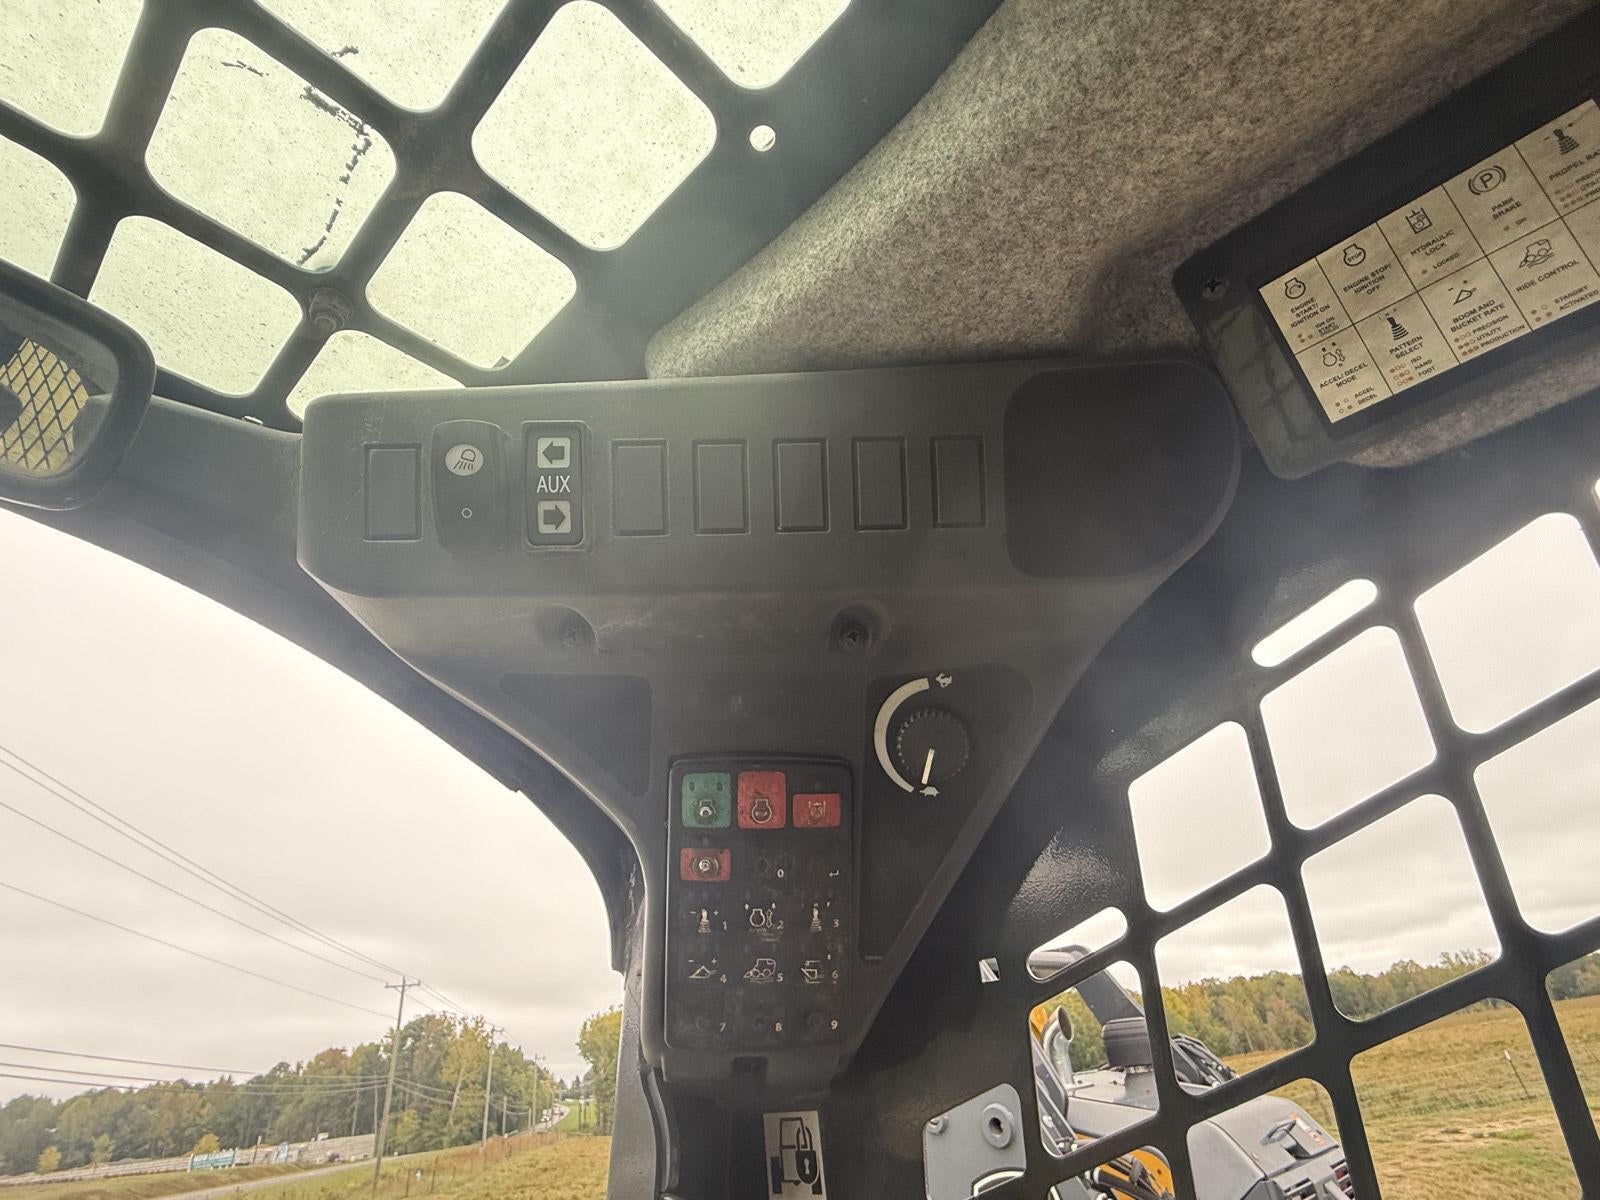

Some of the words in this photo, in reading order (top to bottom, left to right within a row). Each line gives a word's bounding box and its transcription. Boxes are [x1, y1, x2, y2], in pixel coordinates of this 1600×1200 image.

[1480, 172, 1493, 189] P
[1492, 197, 1515, 212] PARK
[1492, 201, 1522, 220] BRAKE
[1410, 229, 1454, 256] HYDRAULIC
[1425, 241, 1447, 256] LOCK
[1347, 251, 1362, 263] STOP
[1433, 252, 1460, 269] LOCKED
[1343, 275, 1369, 292] ENGINE
[1370, 263, 1391, 278] STOP/
[1516, 280, 1537, 292] RIDE
[1538, 259, 1580, 282] CONTROL
[1354, 274, 1385, 294] IGNITION
[1366, 285, 1380, 295] OFF
[1554, 285, 1588, 304] STANDBY
[1559, 289, 1599, 311] ACTIVATED
[1291, 297, 1316, 313] ENGINE
[1295, 303, 1318, 318] START/
[1452, 308, 1477, 323] BOOM
[1478, 299, 1495, 311] AND
[1291, 310, 1319, 328] IGNITION
[1320, 304, 1330, 313] ON
[1451, 314, 1482, 333] BUCKET
[1483, 303, 1505, 316] RATE
[1473, 314, 1509, 334] PRECISION
[1476, 326, 1501, 341] UTILITY
[1480, 324, 1525, 348] PRODUCTION
[1389, 335, 1423, 354] PATTERN
[1395, 342, 1423, 359] SELECT
[1411, 356, 1422, 364] ISO
[1414, 359, 1433, 370] HAND
[1320, 373, 1344, 389] ACCEL/
[1344, 362, 1369, 376] DECEL
[1418, 366, 1435, 376] FOOT
[1336, 375, 1357, 388] MODE
[1355, 386, 1375, 398] ACCEL
[1357, 394, 1378, 405] DECEL
[536, 475, 571, 493] AUX
[776, 868, 785, 878] 0
[722, 921, 728, 931] 1
[777, 920, 784, 930] 2
[832, 919, 840, 928] 3
[720, 974, 727, 984] 4
[777, 973, 784, 982] 5
[831, 970, 839, 980] 6
[720, 1022, 727, 1032] 7
[775, 1022, 782, 1032] 8
[830, 1020, 838, 1030] 9
